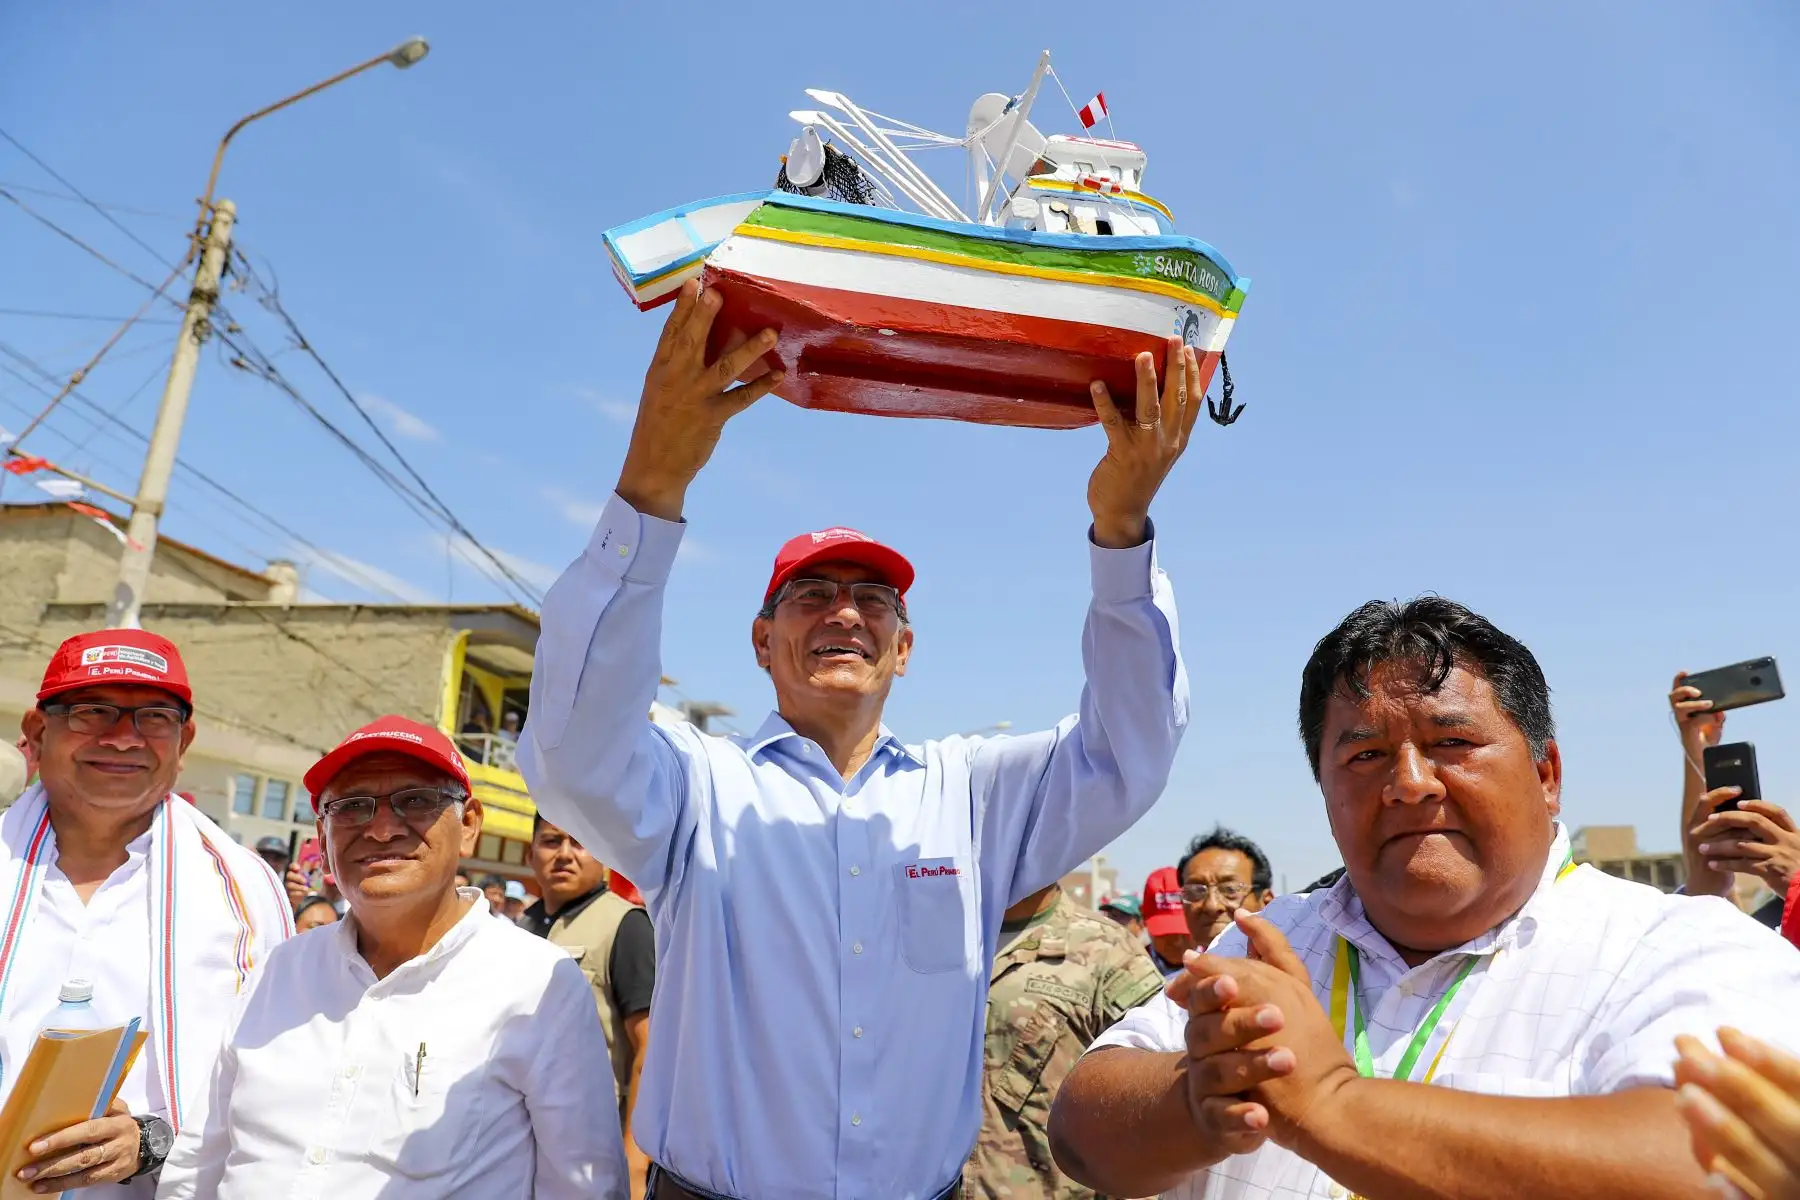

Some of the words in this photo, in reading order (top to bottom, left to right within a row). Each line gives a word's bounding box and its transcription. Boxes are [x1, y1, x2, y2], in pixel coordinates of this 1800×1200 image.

[1154, 255, 1198, 283] SANTA
[1199, 268, 1219, 296] ROSA
[91, 667, 102, 676] EL
[103, 666, 123, 675] PERÚ
[909, 868, 921, 879] EL
[921, 867, 938, 877] PERÚ
